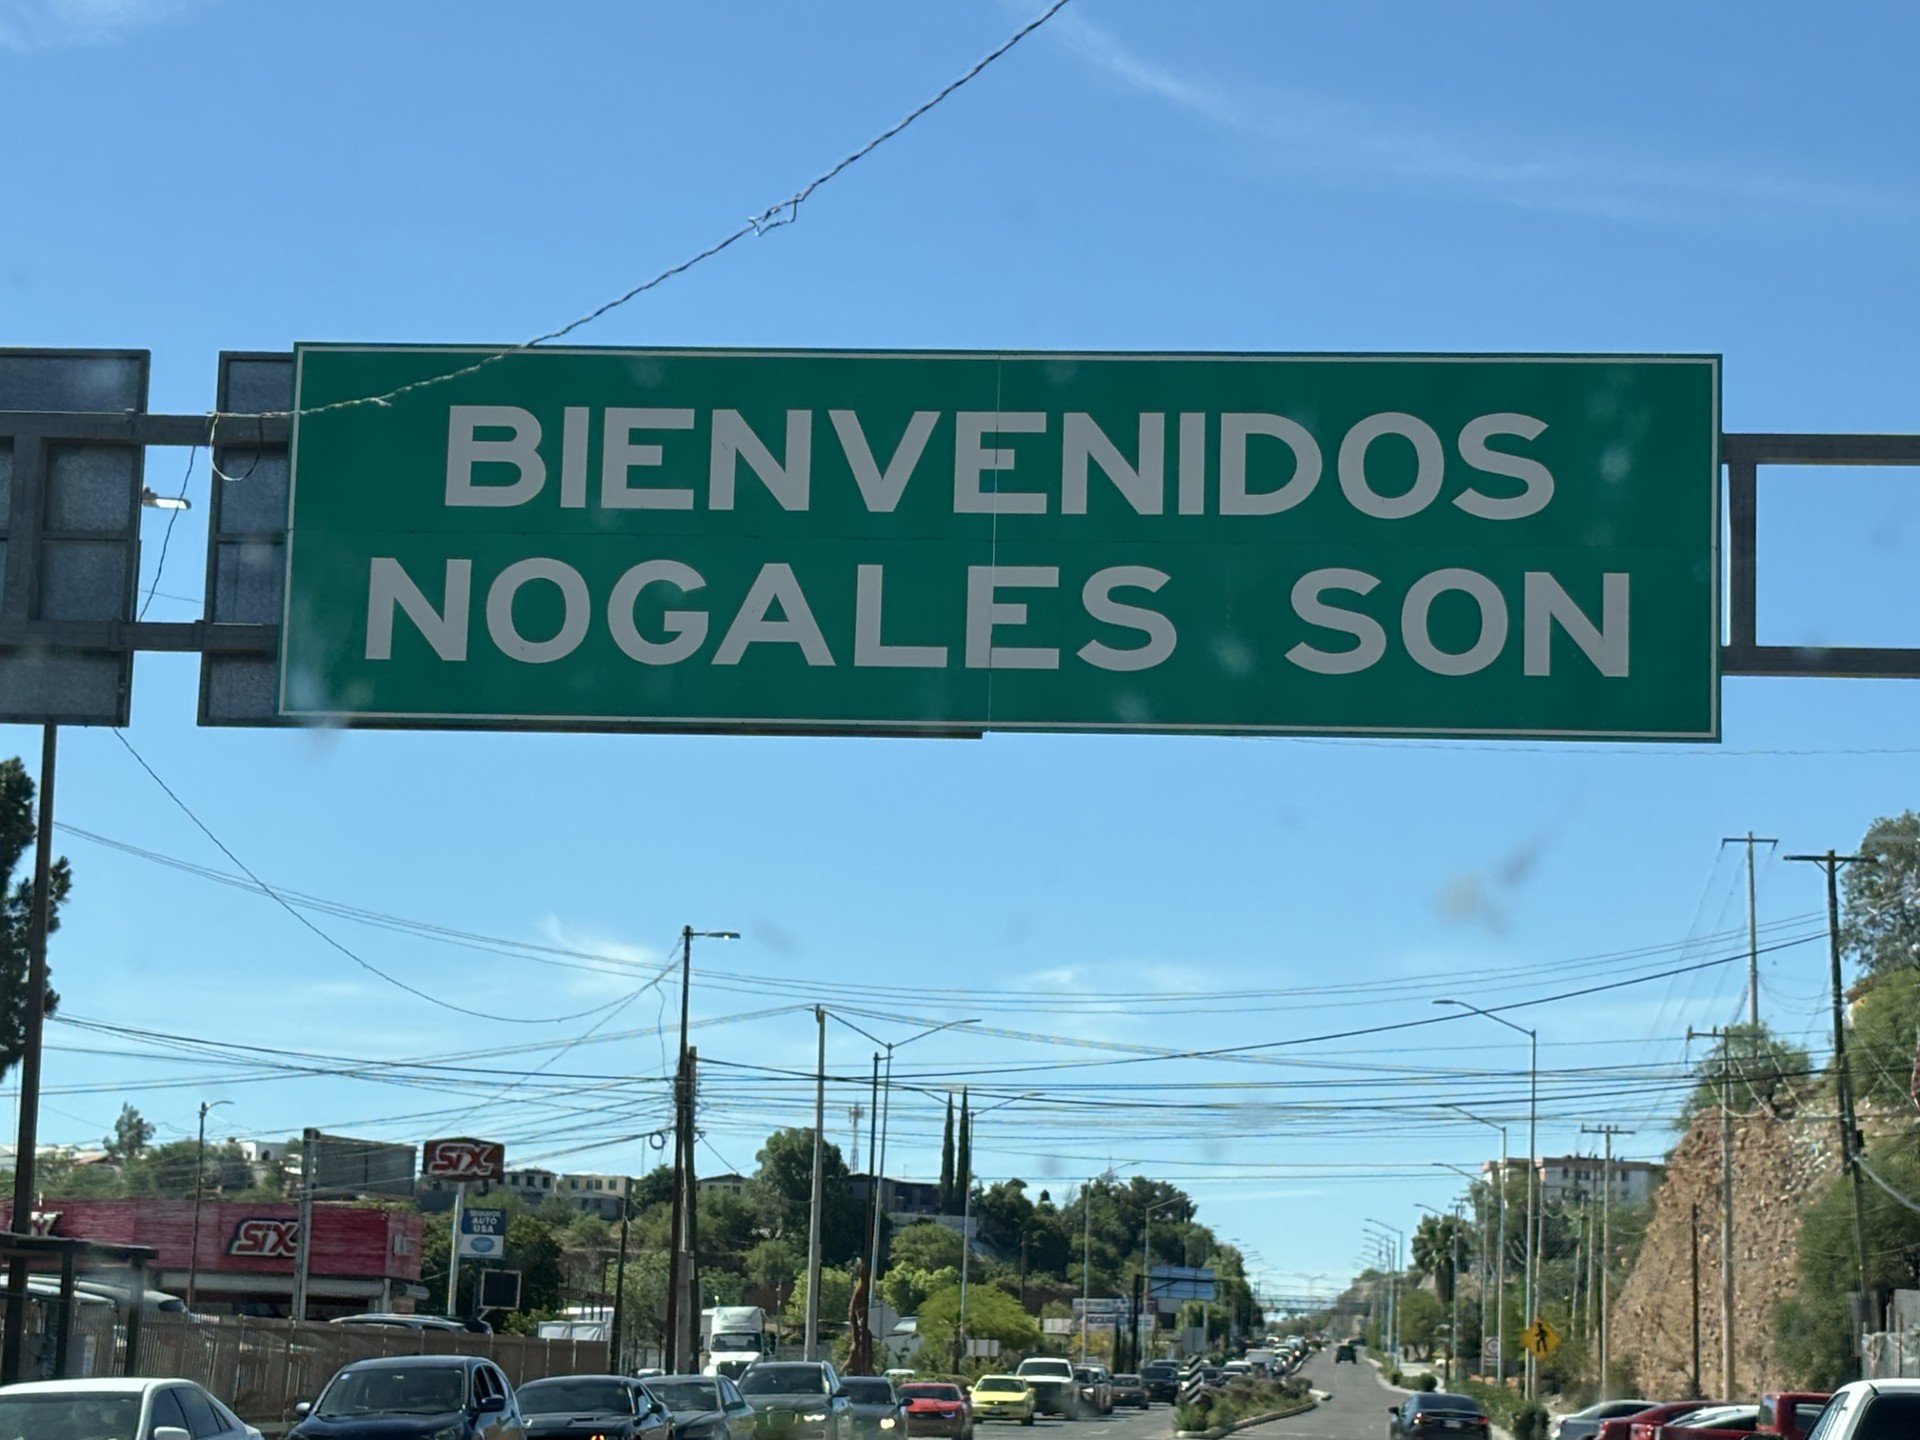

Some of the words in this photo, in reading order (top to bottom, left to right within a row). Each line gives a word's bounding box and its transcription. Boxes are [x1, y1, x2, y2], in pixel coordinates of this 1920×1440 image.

[444, 405, 1555, 520] BIENVENIDOS
[365, 557, 1178, 671] NOGALES
[1284, 568, 1630, 677] SON
[472, 1217, 498, 1225] AUTO
[473, 1224, 495, 1233] USA
